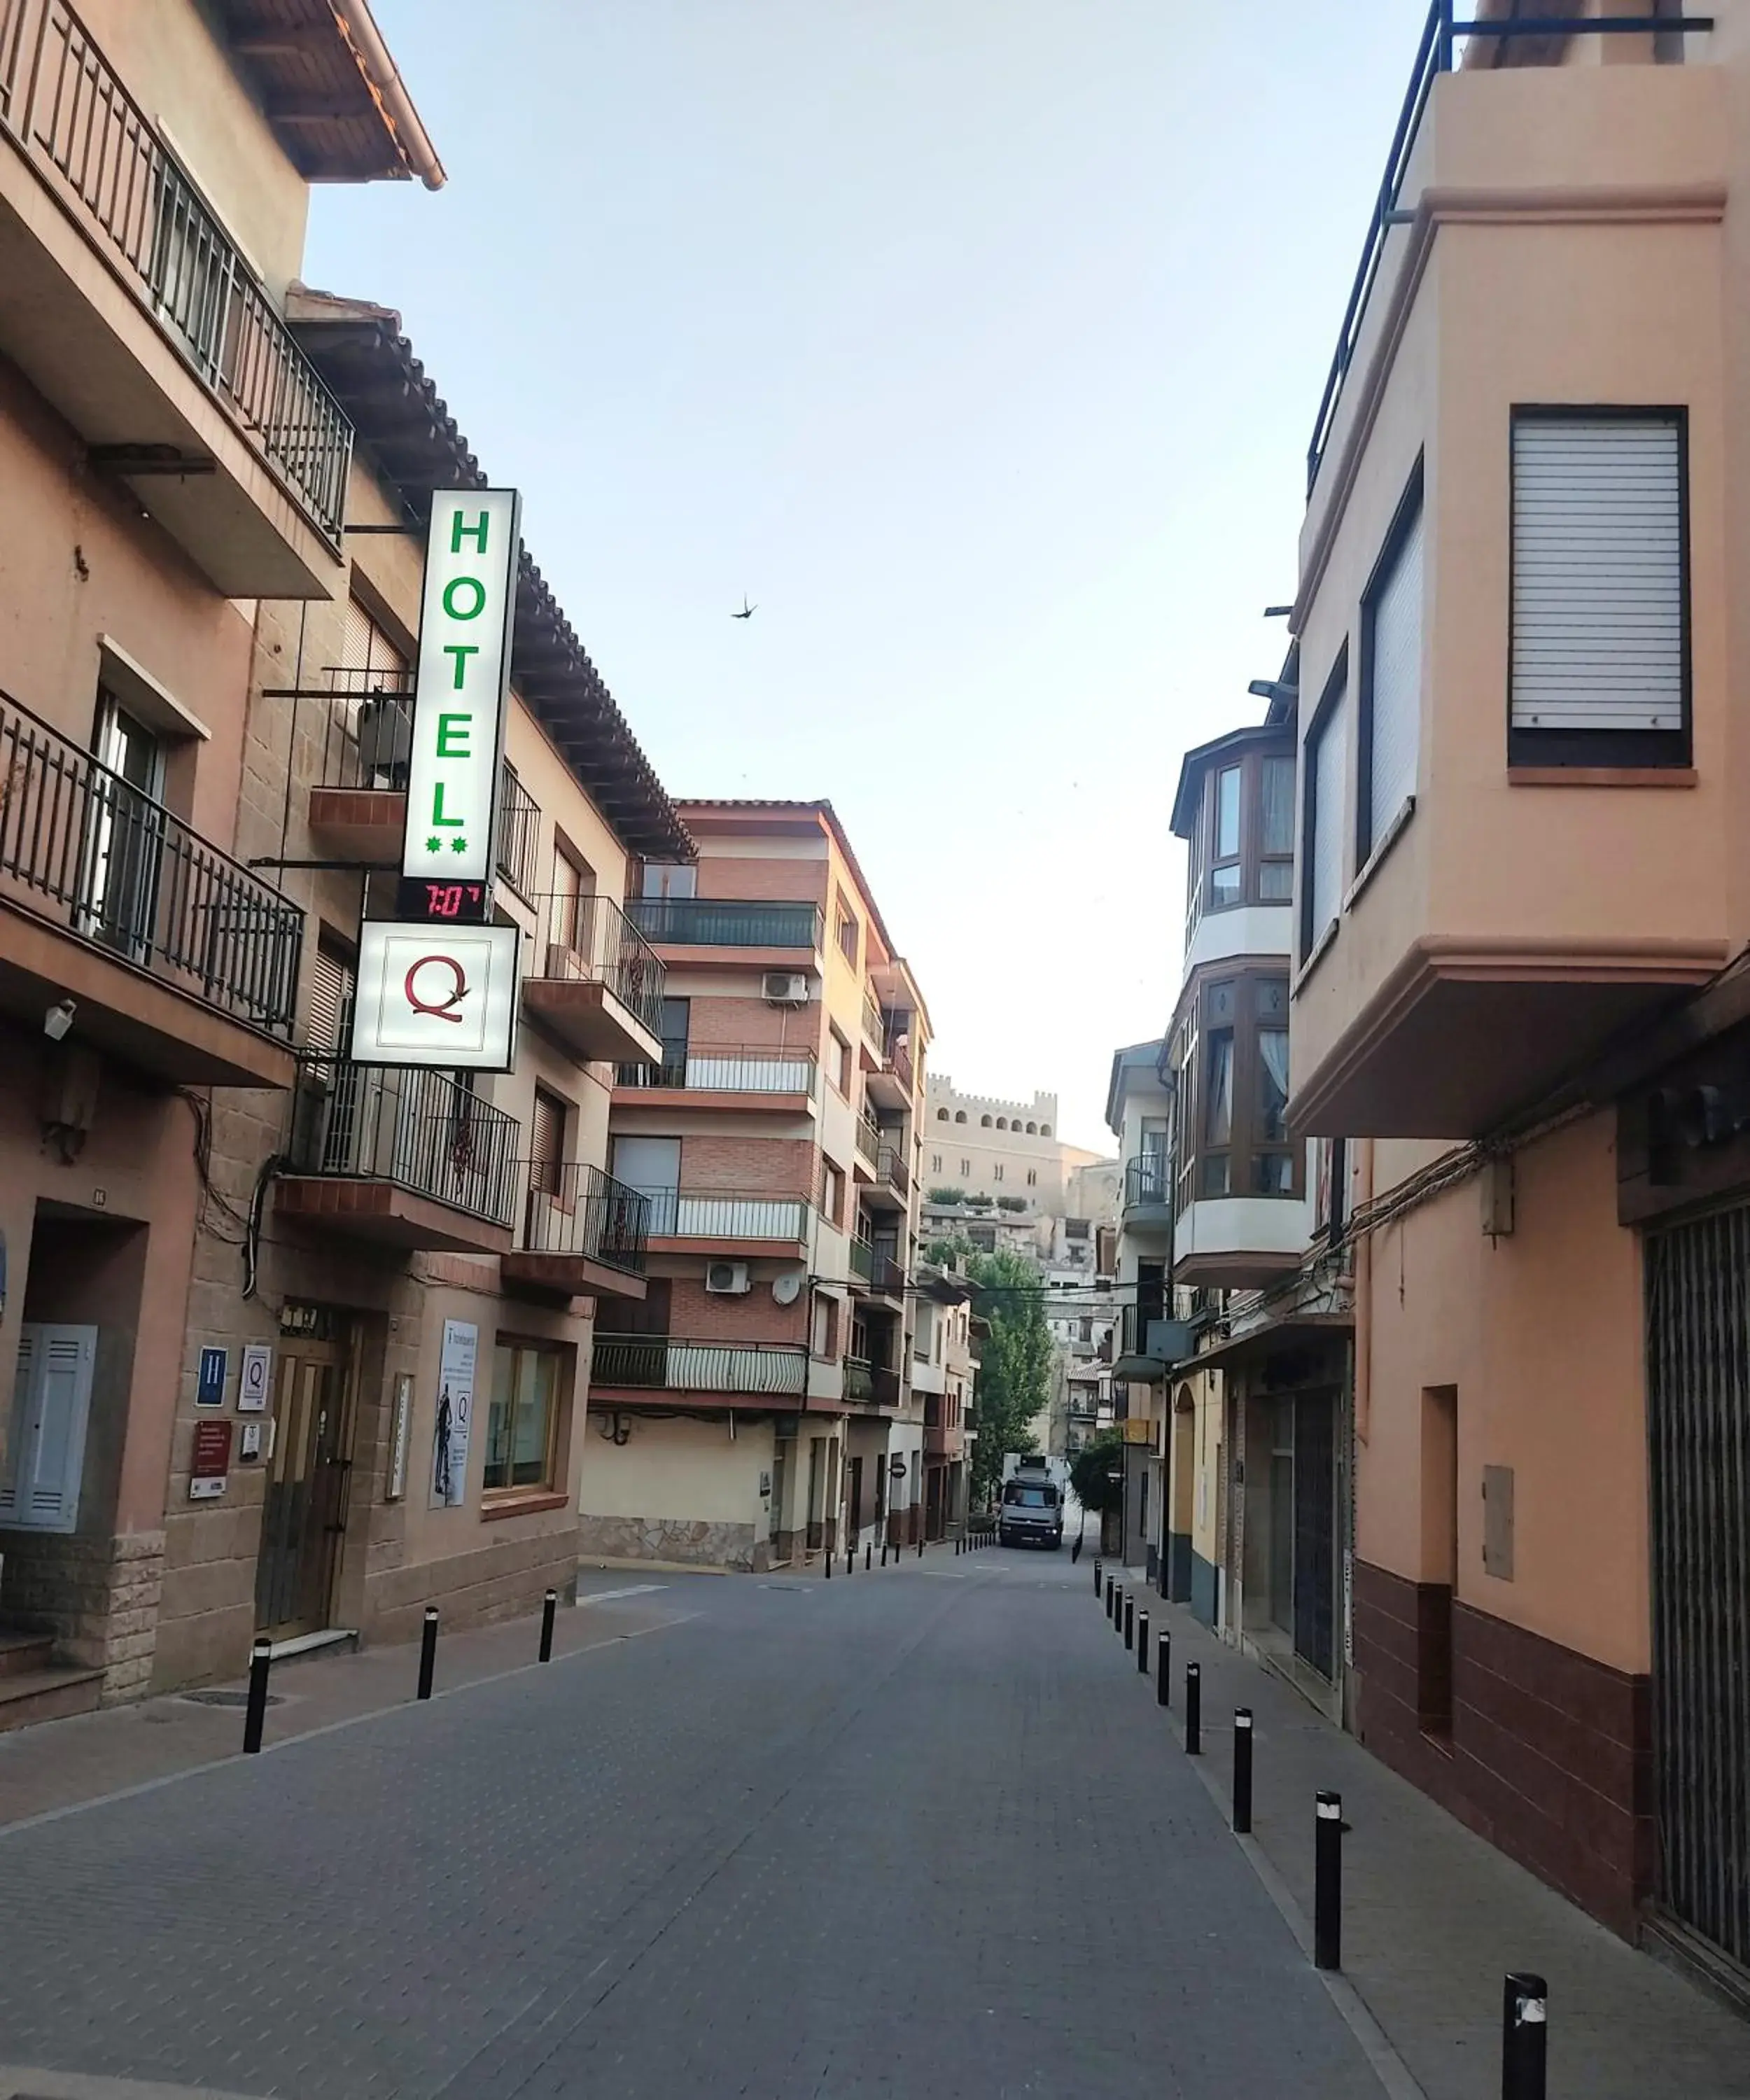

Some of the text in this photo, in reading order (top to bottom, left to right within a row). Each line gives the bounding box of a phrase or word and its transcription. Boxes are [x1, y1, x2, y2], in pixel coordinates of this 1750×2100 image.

[430, 510, 489, 827] HOTEL
[405, 955, 470, 1023] Q
[206, 1354, 220, 1382] H
[250, 1362, 262, 1390] Q
[458, 1396, 467, 1423] Q
